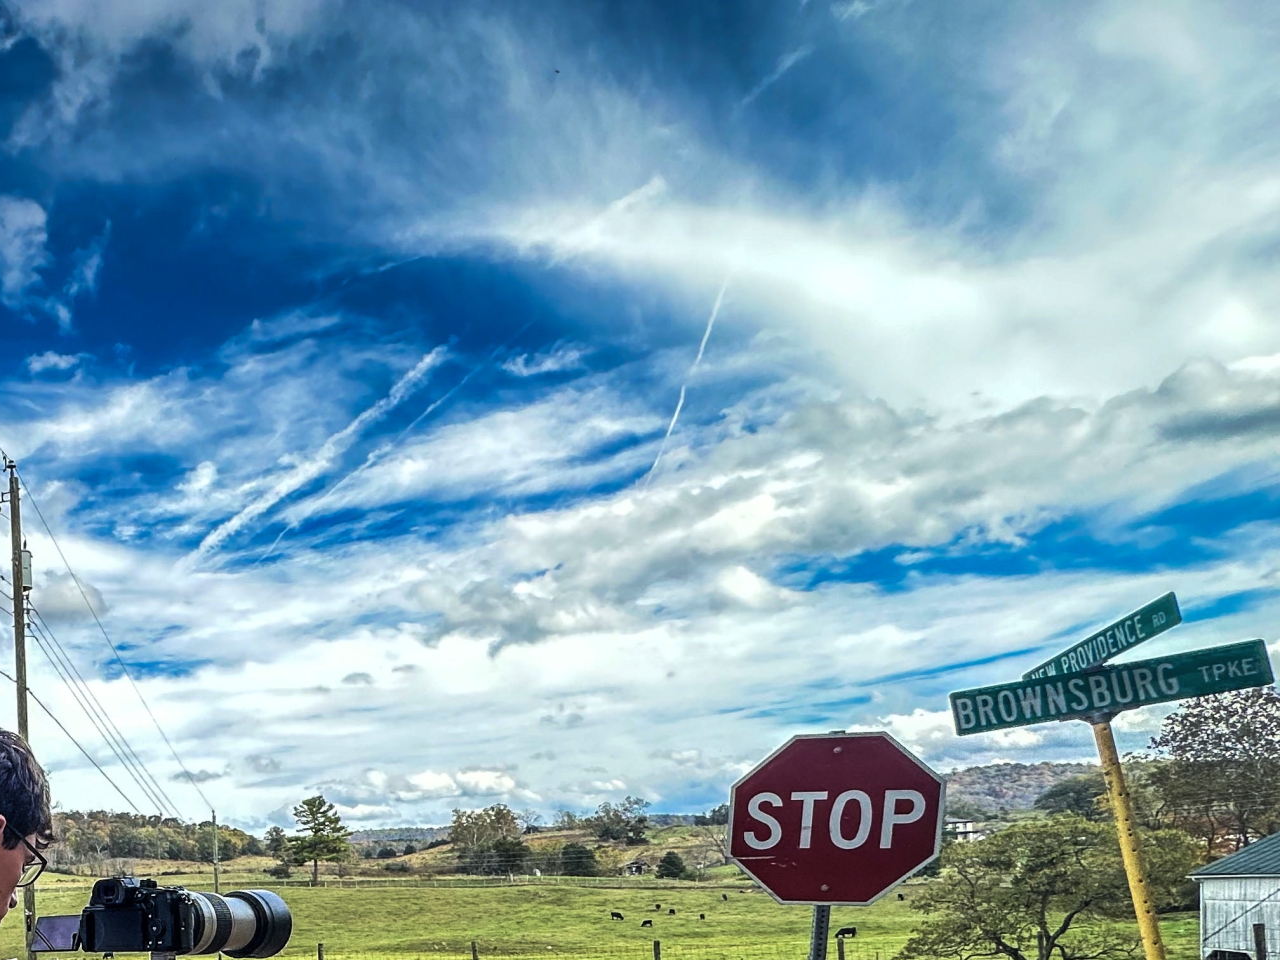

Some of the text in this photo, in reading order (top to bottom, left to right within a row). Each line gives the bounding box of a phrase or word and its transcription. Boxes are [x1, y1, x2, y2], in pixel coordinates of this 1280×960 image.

[1060, 615, 1145, 674] PROVIDENCE
[1152, 611, 1167, 628] RD
[956, 658, 1258, 730] BROWNSBURG TPKE
[743, 789, 926, 850] STOP
